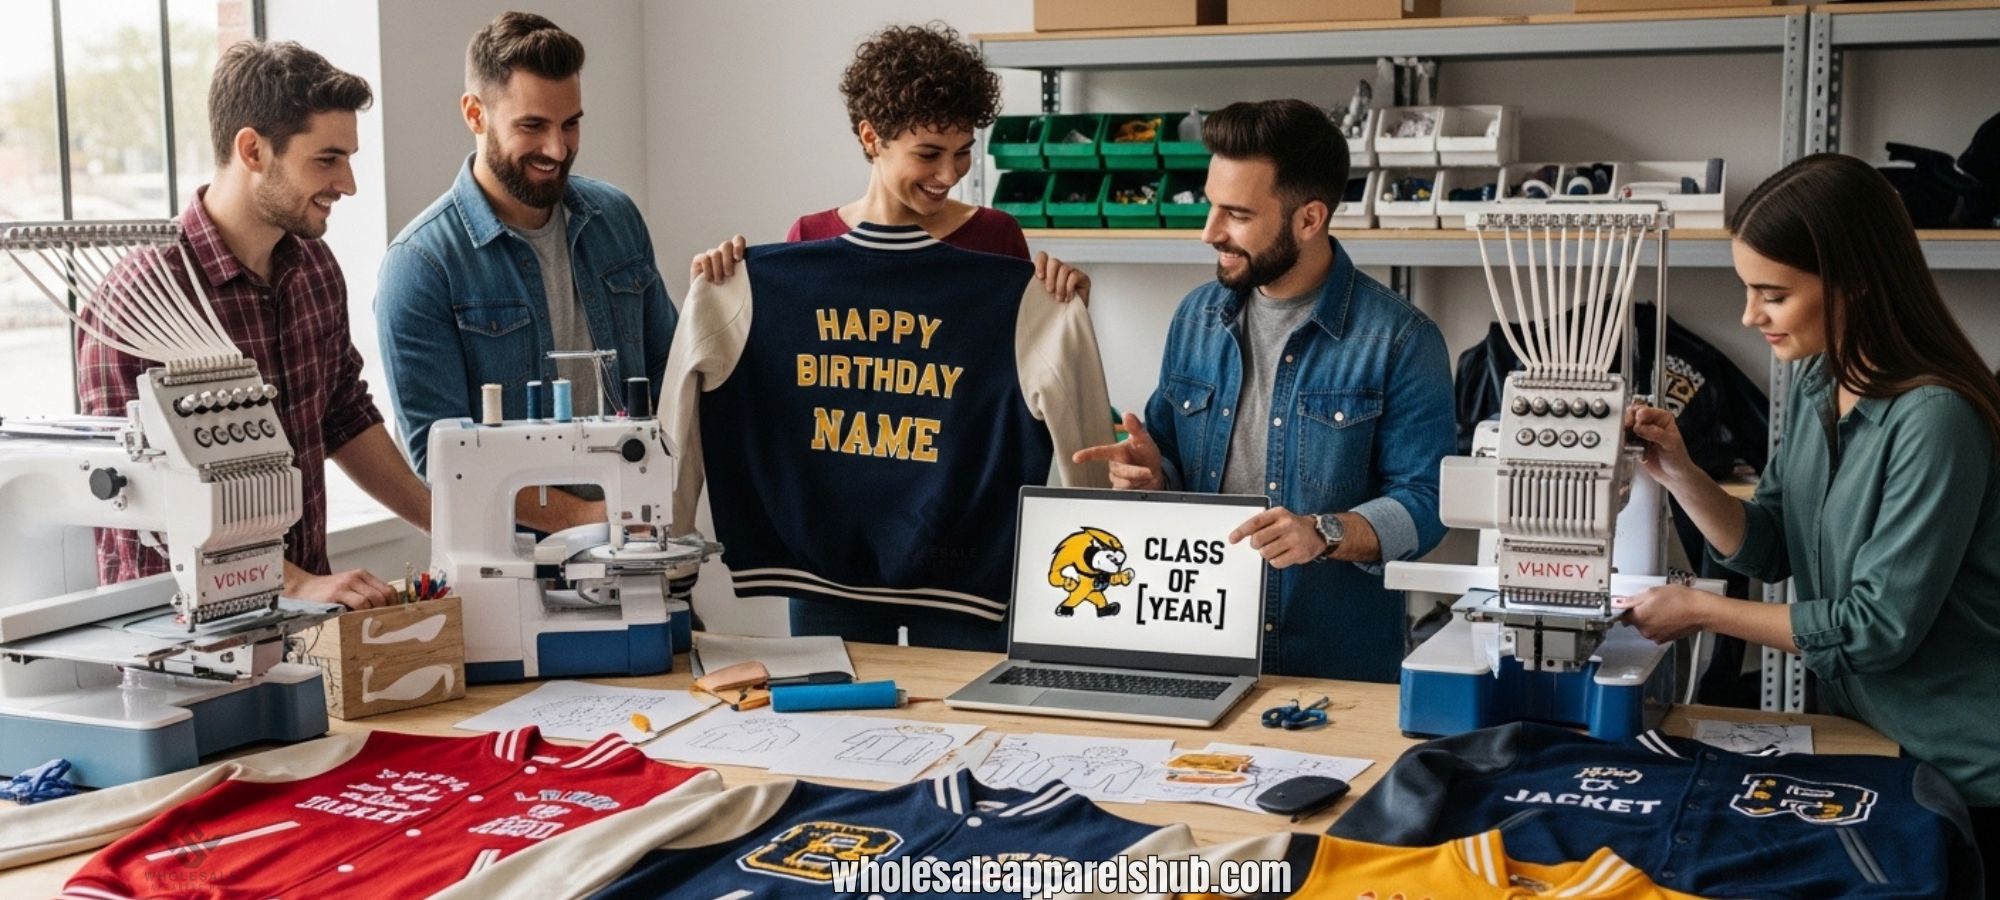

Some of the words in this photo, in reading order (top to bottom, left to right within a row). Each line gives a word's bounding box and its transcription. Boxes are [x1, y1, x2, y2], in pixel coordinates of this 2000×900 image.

[815, 307, 943, 349] HAPPY
[796, 353, 964, 399] BIRTHDAY
[811, 406, 941, 463] NAME
[1144, 537, 1225, 565] CLASS
[1168, 568, 1199, 593] OF
[1503, 788, 1662, 815] JACKET
